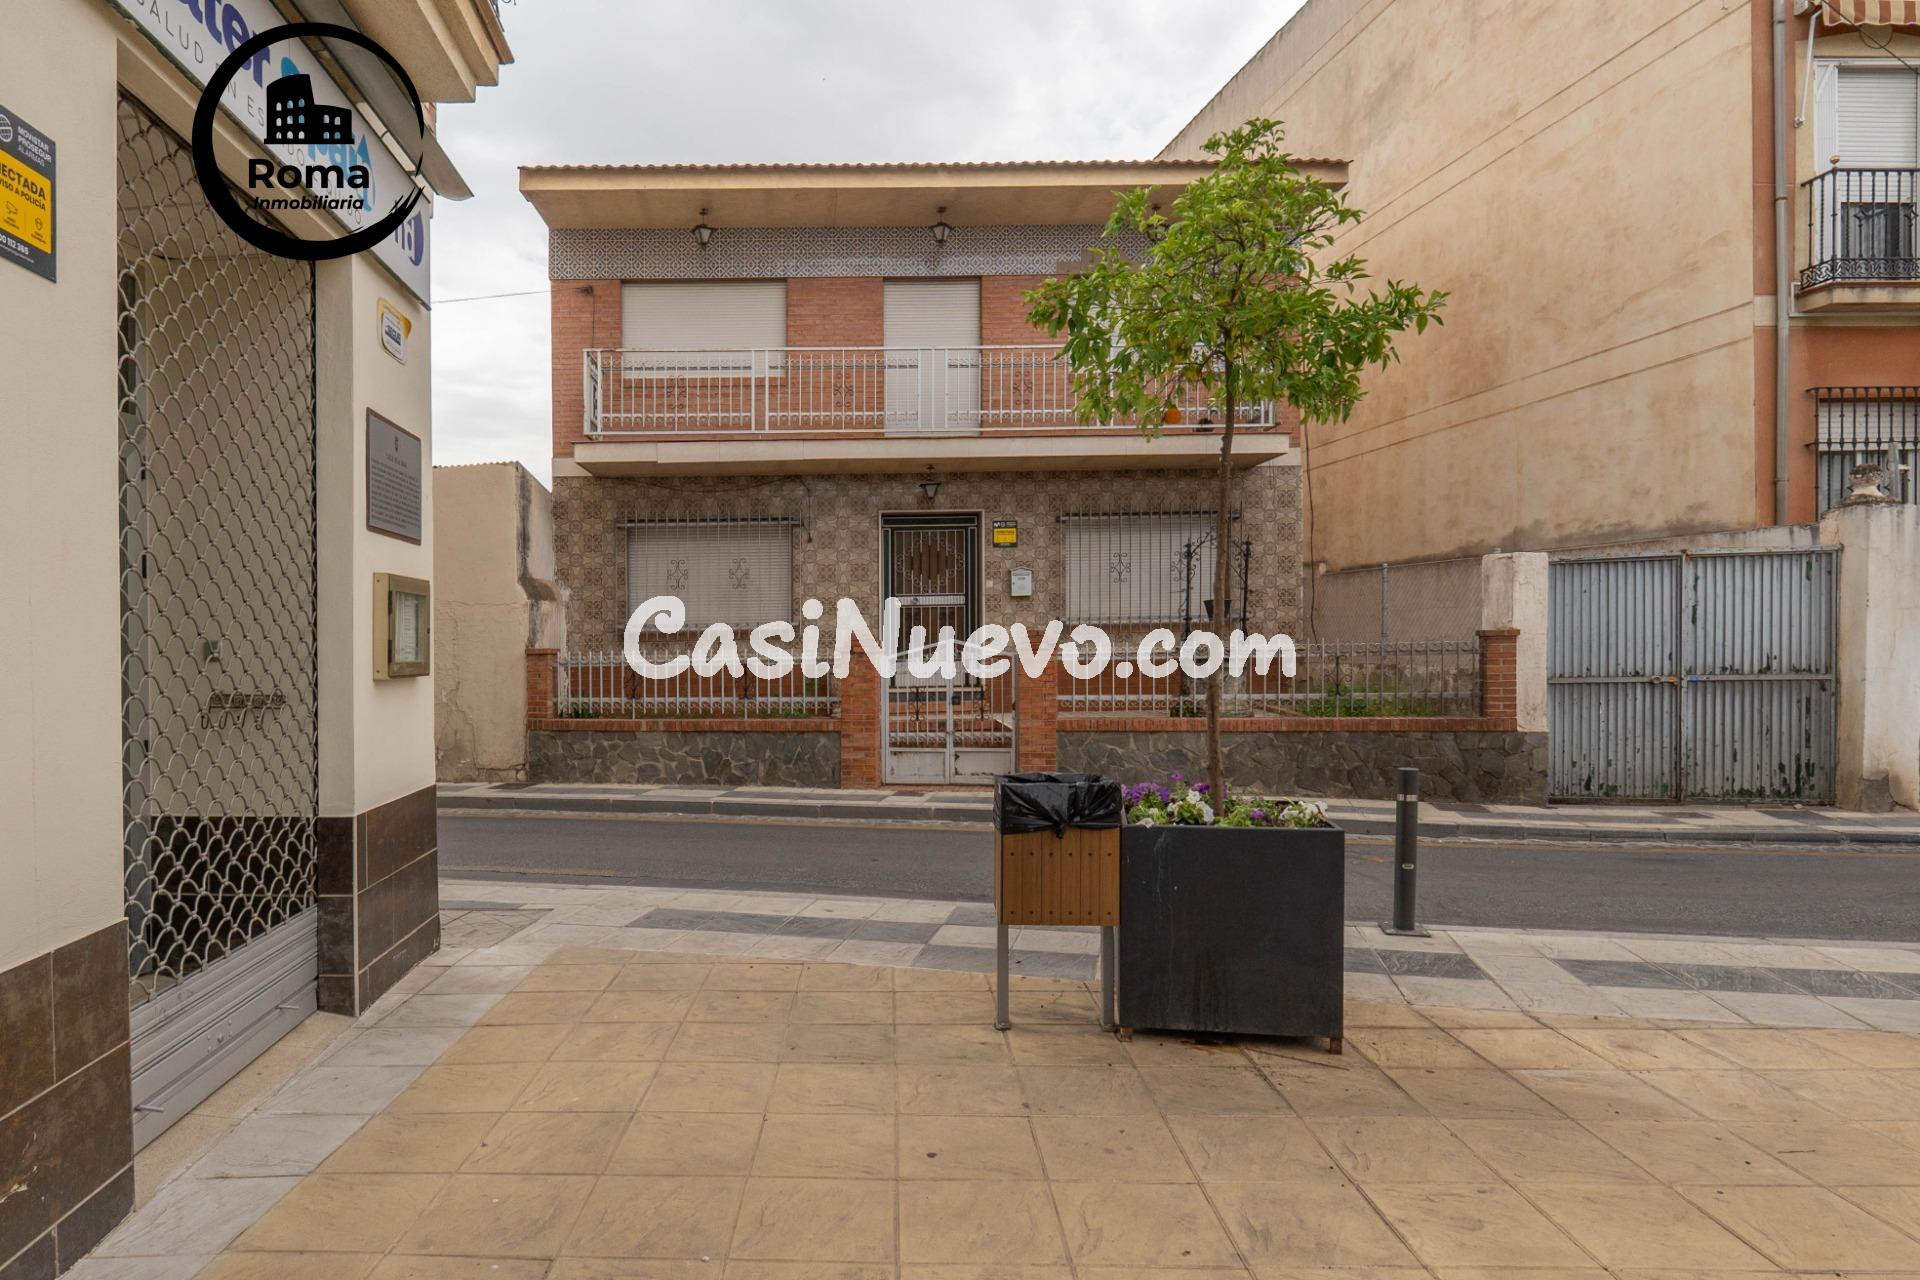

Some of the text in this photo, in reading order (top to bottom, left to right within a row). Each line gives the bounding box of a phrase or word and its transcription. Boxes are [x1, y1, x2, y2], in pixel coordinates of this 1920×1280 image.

[18, 126, 49, 152] MOVISTAR
[18, 135, 52, 163] PROSEGUR
[0, 163, 46, 201] ECTADA
